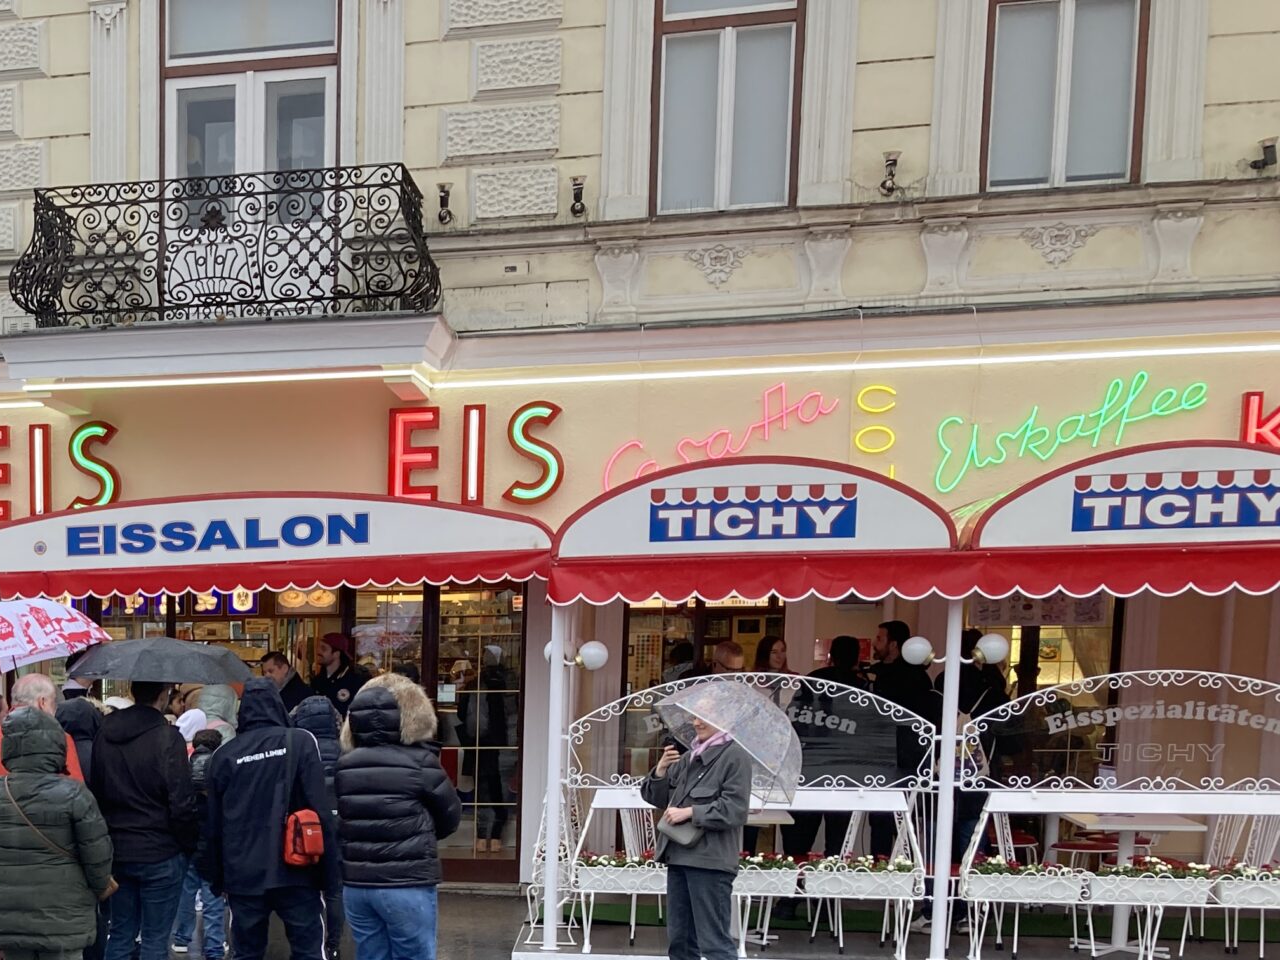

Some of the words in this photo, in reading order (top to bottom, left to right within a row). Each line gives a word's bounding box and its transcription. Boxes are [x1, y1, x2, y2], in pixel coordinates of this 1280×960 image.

[387, 400, 564, 506] EIS
[658, 505, 846, 538] TICHY
[1083, 492, 1280, 527] TICHY
[66, 511, 370, 557] EISSALON
[1044, 700, 1280, 735] Eisspezialitäten
[1096, 743, 1226, 762] TICHY
